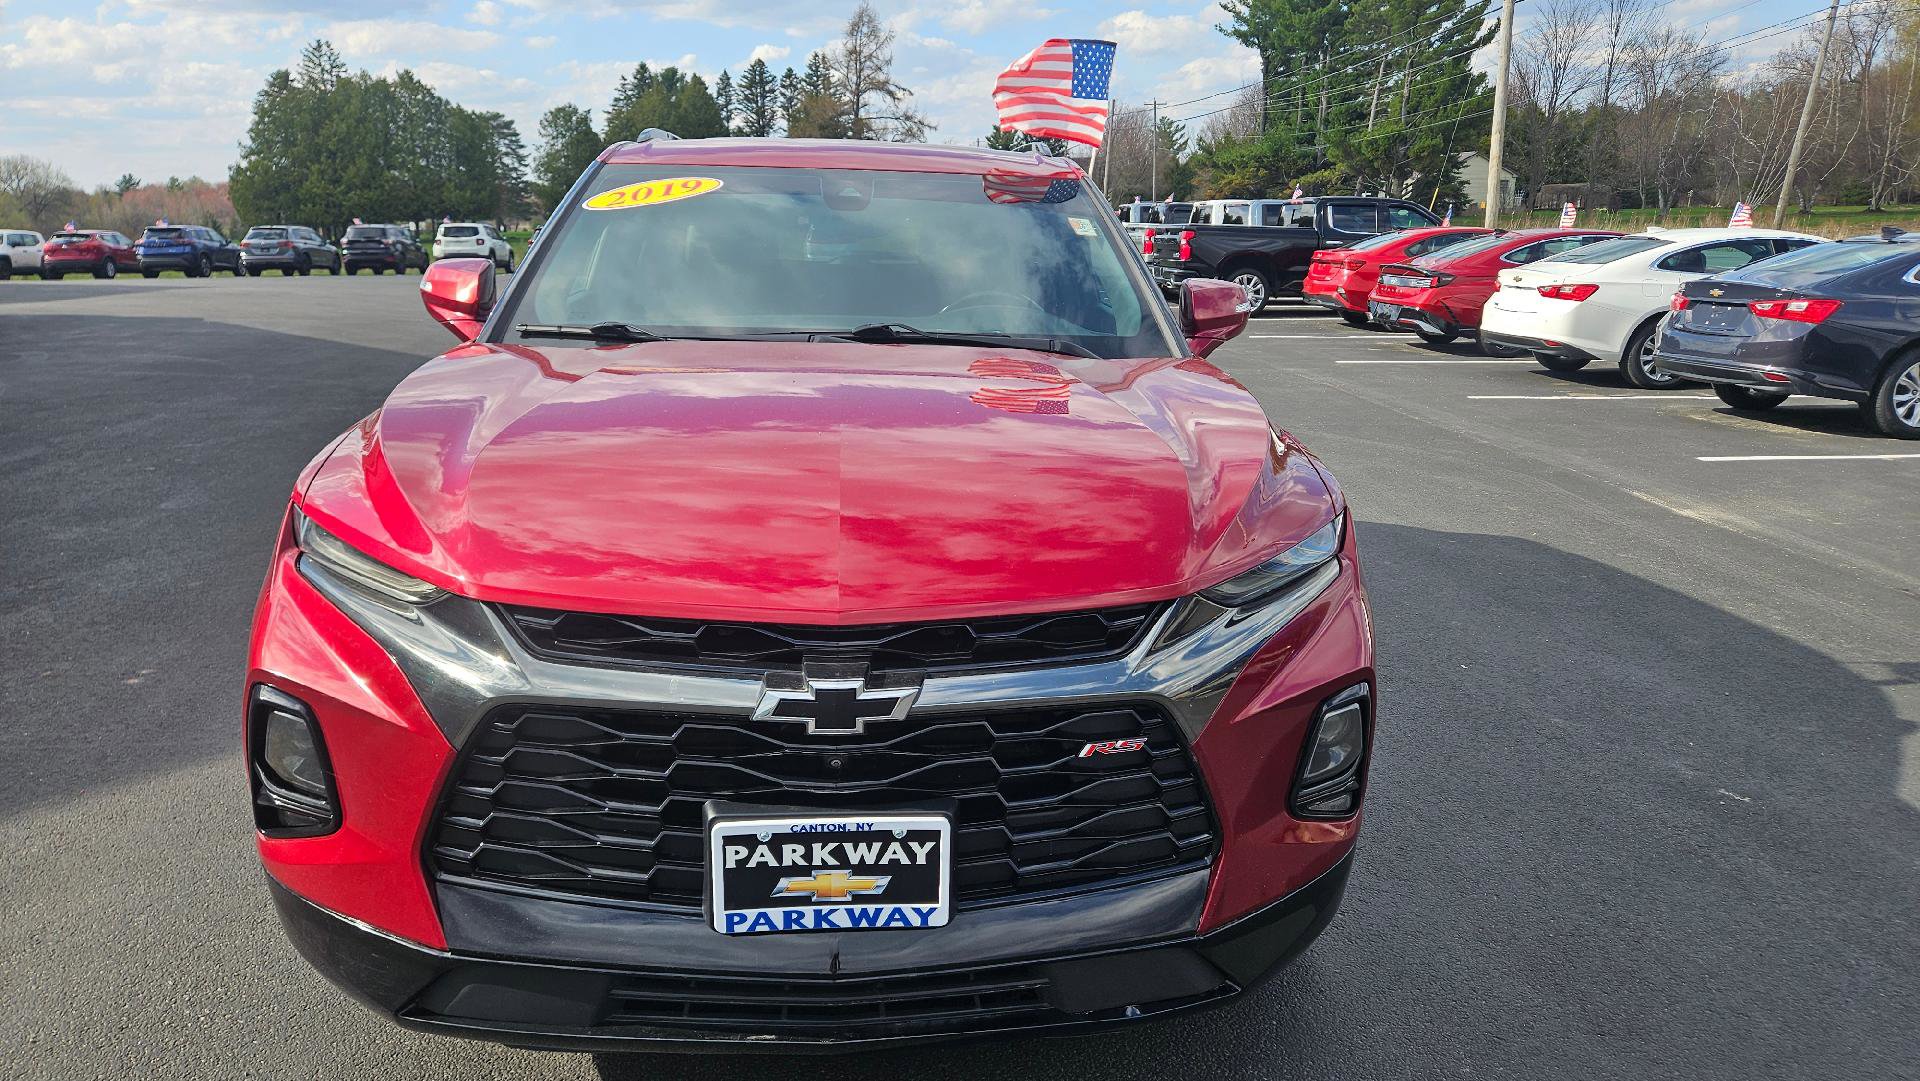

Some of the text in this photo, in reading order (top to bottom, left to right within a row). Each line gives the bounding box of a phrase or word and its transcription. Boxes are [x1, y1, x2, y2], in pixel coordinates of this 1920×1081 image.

[606, 180, 702, 206] 2019
[1078, 738, 1147, 757] RS
[790, 822, 875, 833] CANTON, NY
[724, 841, 937, 868] PARKWAY
[724, 907, 938, 933] PARKWAY
